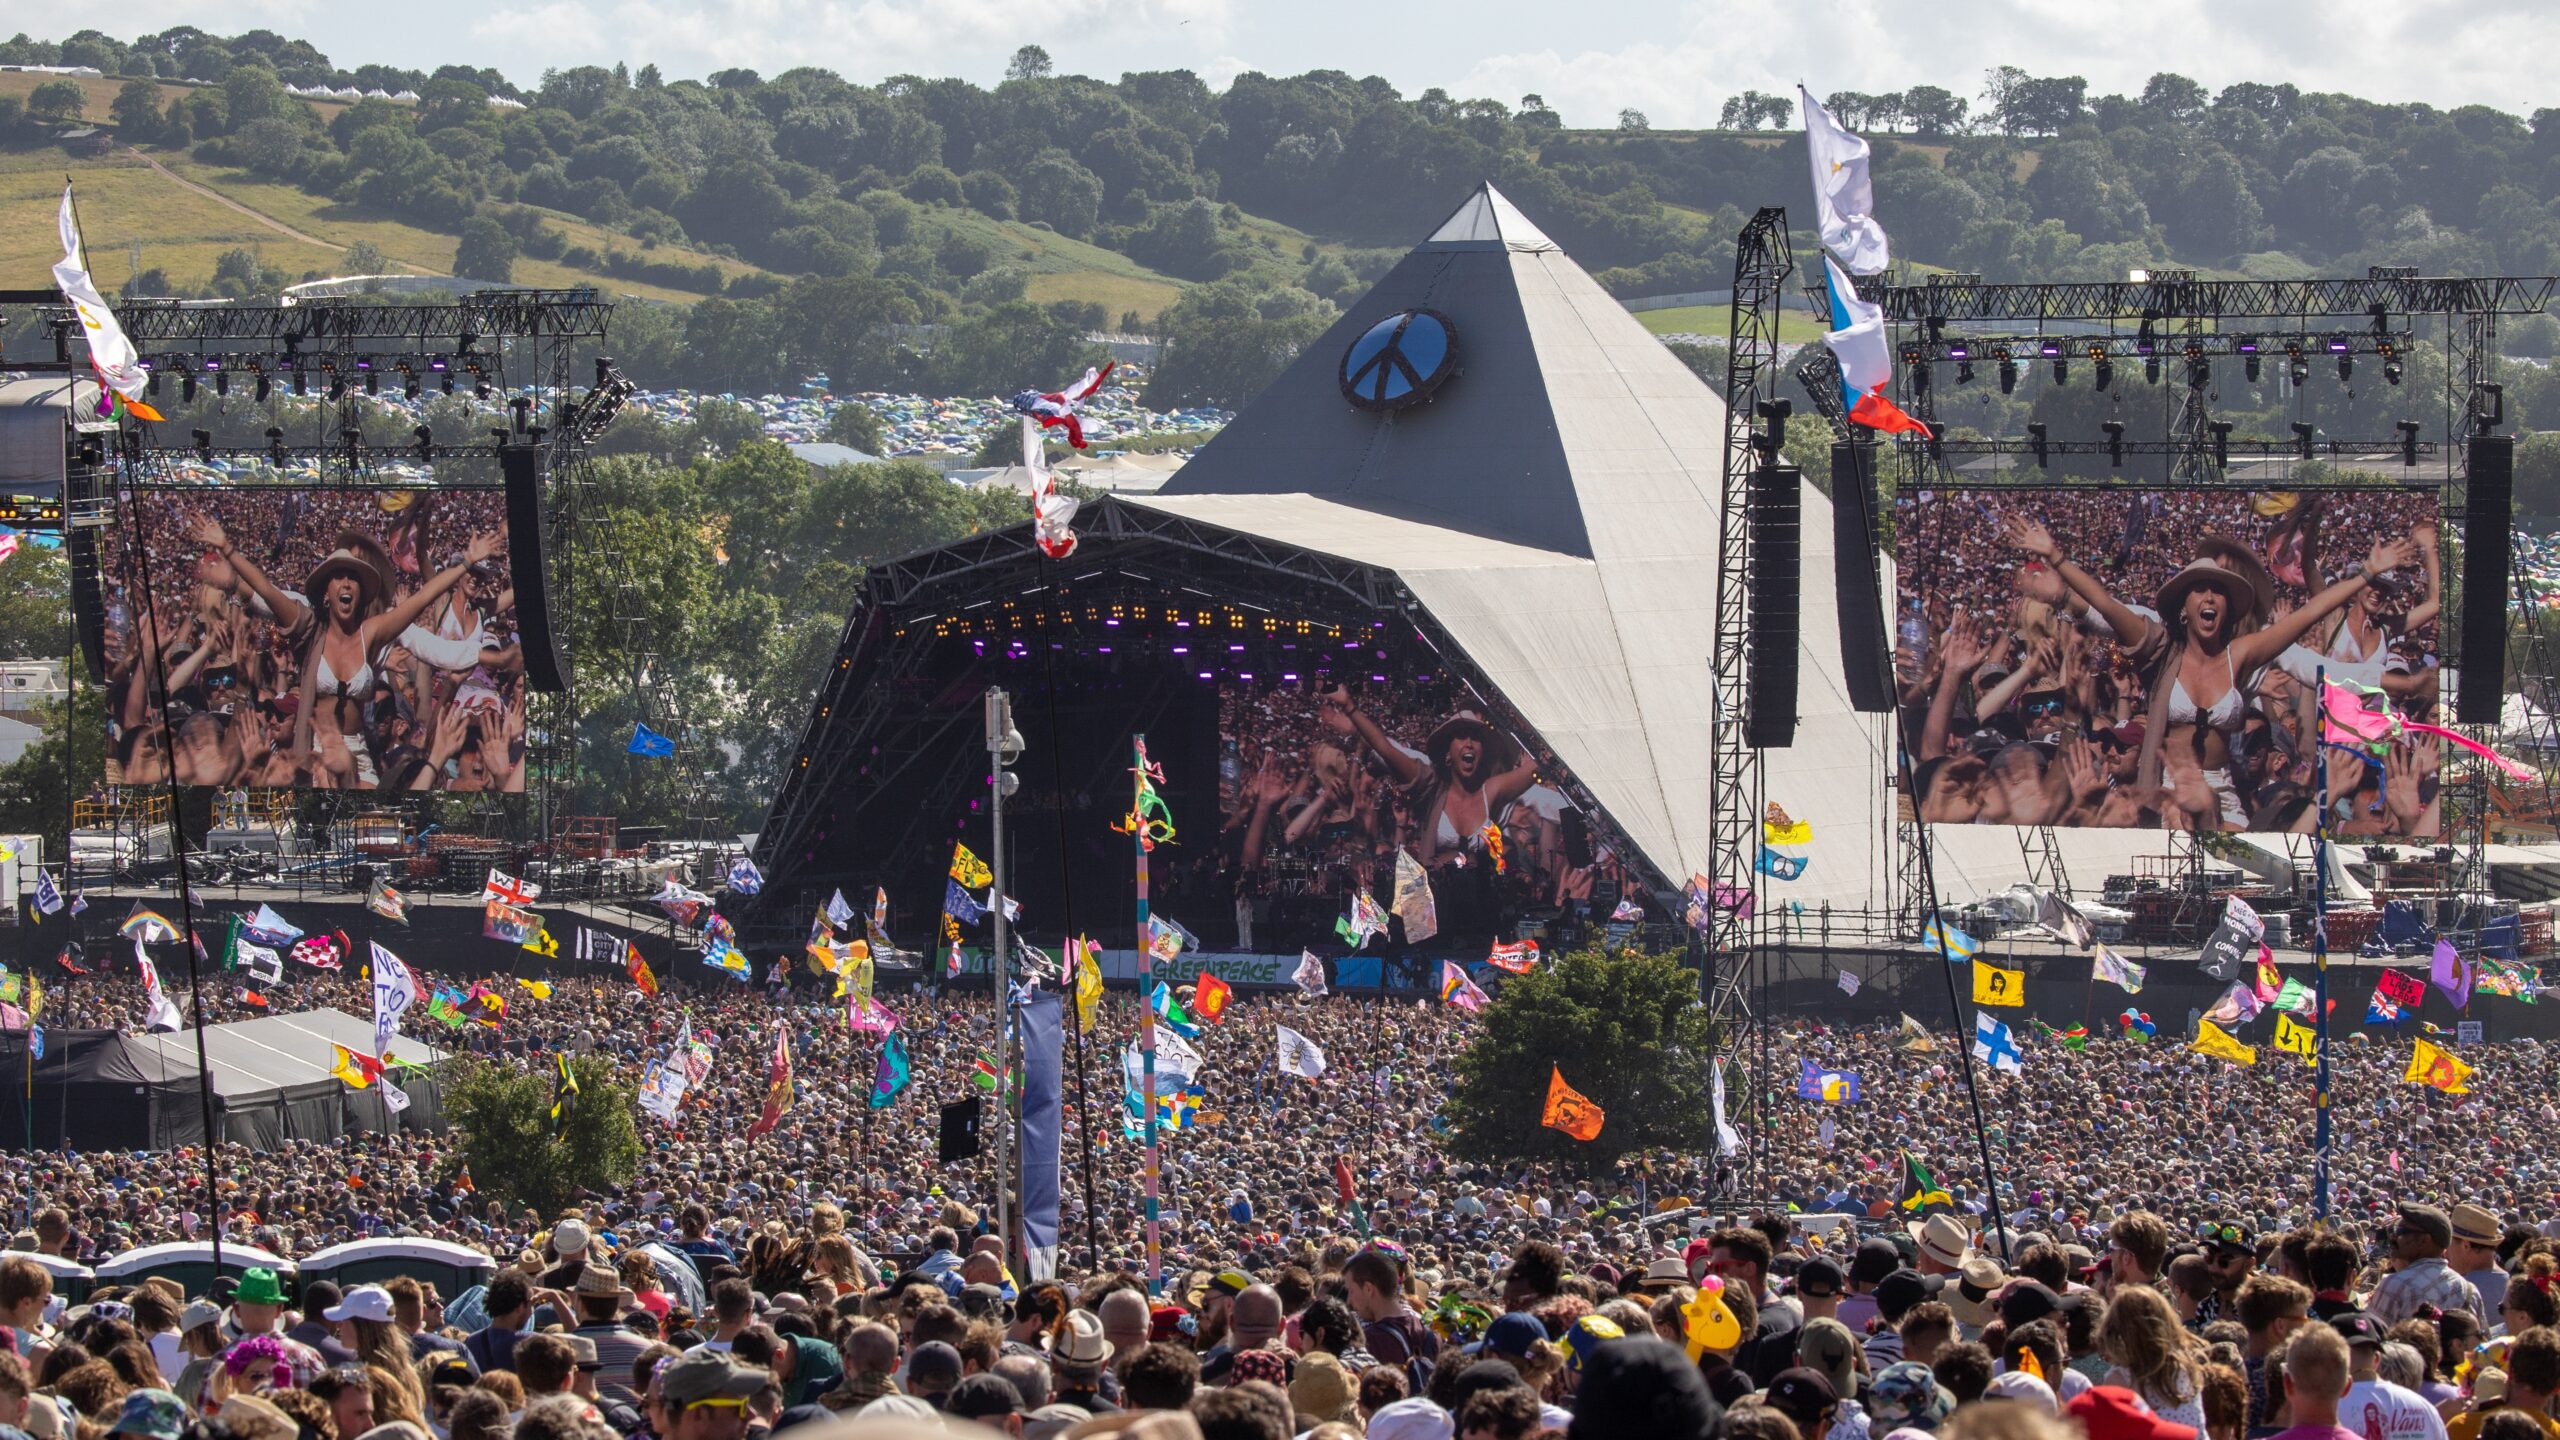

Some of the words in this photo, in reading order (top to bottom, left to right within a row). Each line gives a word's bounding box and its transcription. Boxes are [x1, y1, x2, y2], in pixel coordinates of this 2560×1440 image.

[2224, 916, 2252, 938] MONDA
[2231, 933, 2240, 942] IS
[594, 941, 612, 949] CITY
[1152, 960, 1281, 981] GREENPEACE
[2390, 979, 2414, 994] LADS
[376, 984, 406, 1012] TO
[2391, 1408, 2425, 1432] Vans
